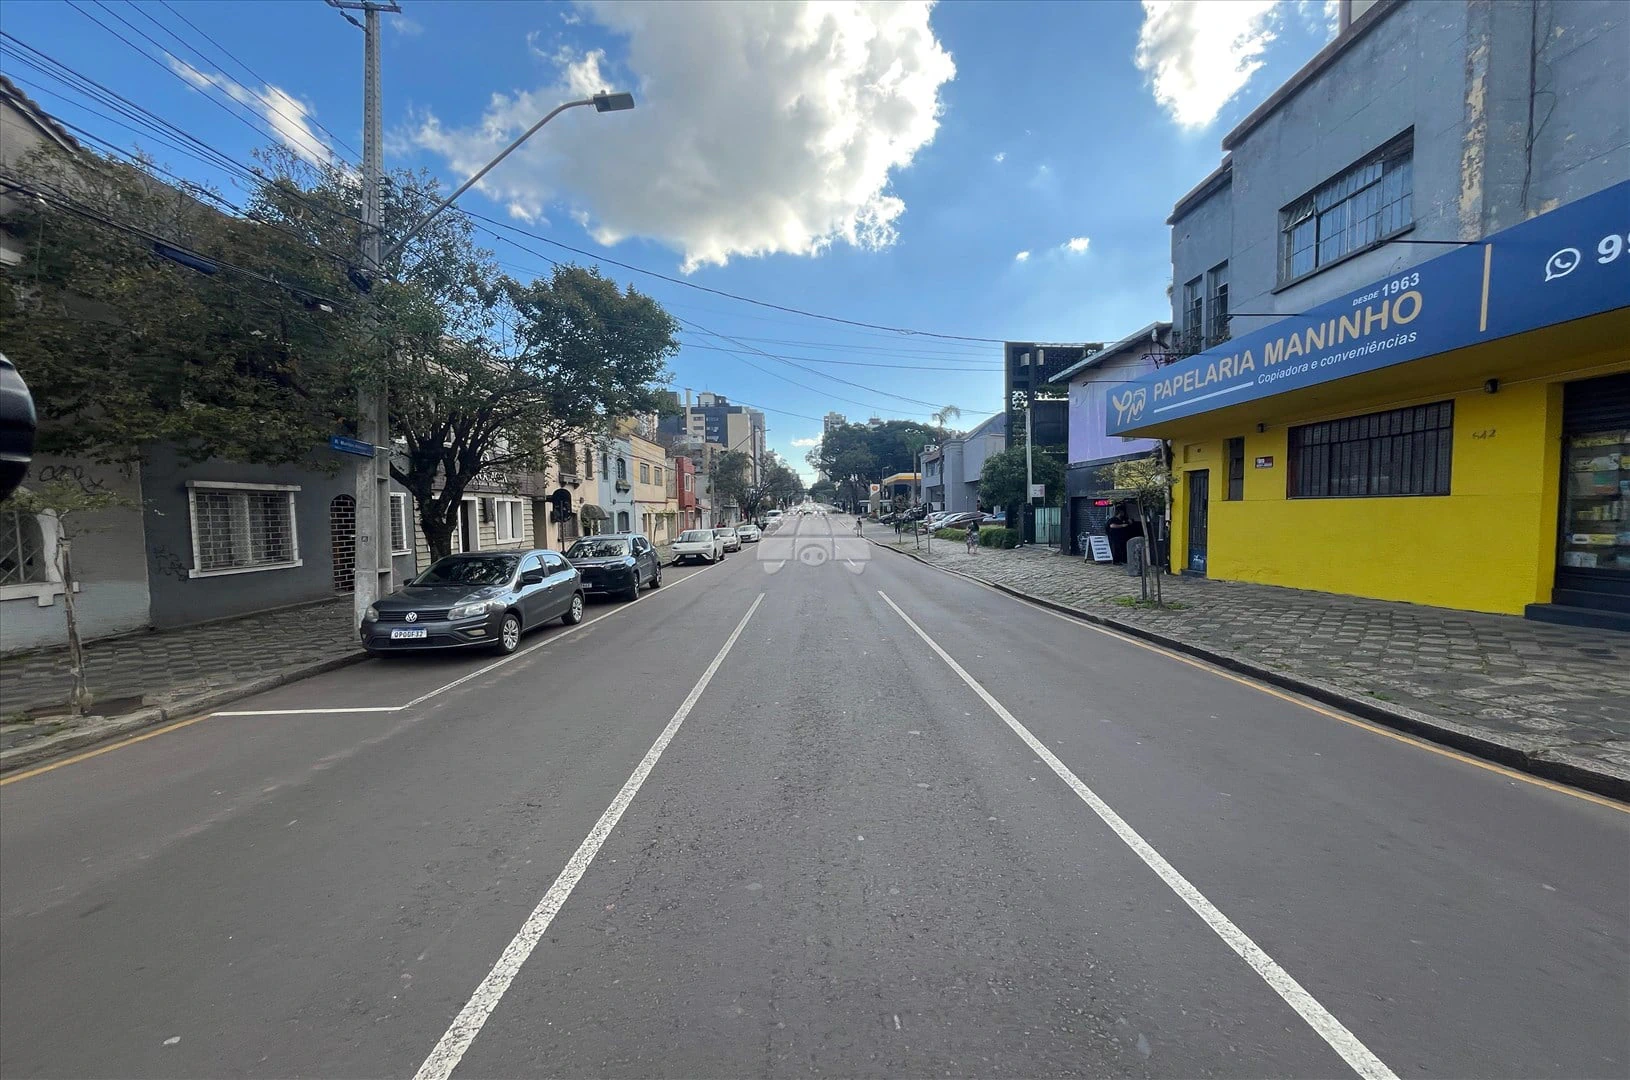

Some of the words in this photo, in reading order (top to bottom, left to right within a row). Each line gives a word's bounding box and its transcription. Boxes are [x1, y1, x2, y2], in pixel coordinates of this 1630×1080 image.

[1597, 232, 1630, 264] 9
[1352, 291, 1380, 306] DESDE
[1382, 272, 1420, 297] 1963
[1153, 350, 1256, 402] PAPELARIA
[1264, 290, 1423, 367] MANINHO
[1258, 361, 1309, 385] Copiadora
[1310, 359, 1318, 371] e
[1320, 331, 1418, 367] conveniências
